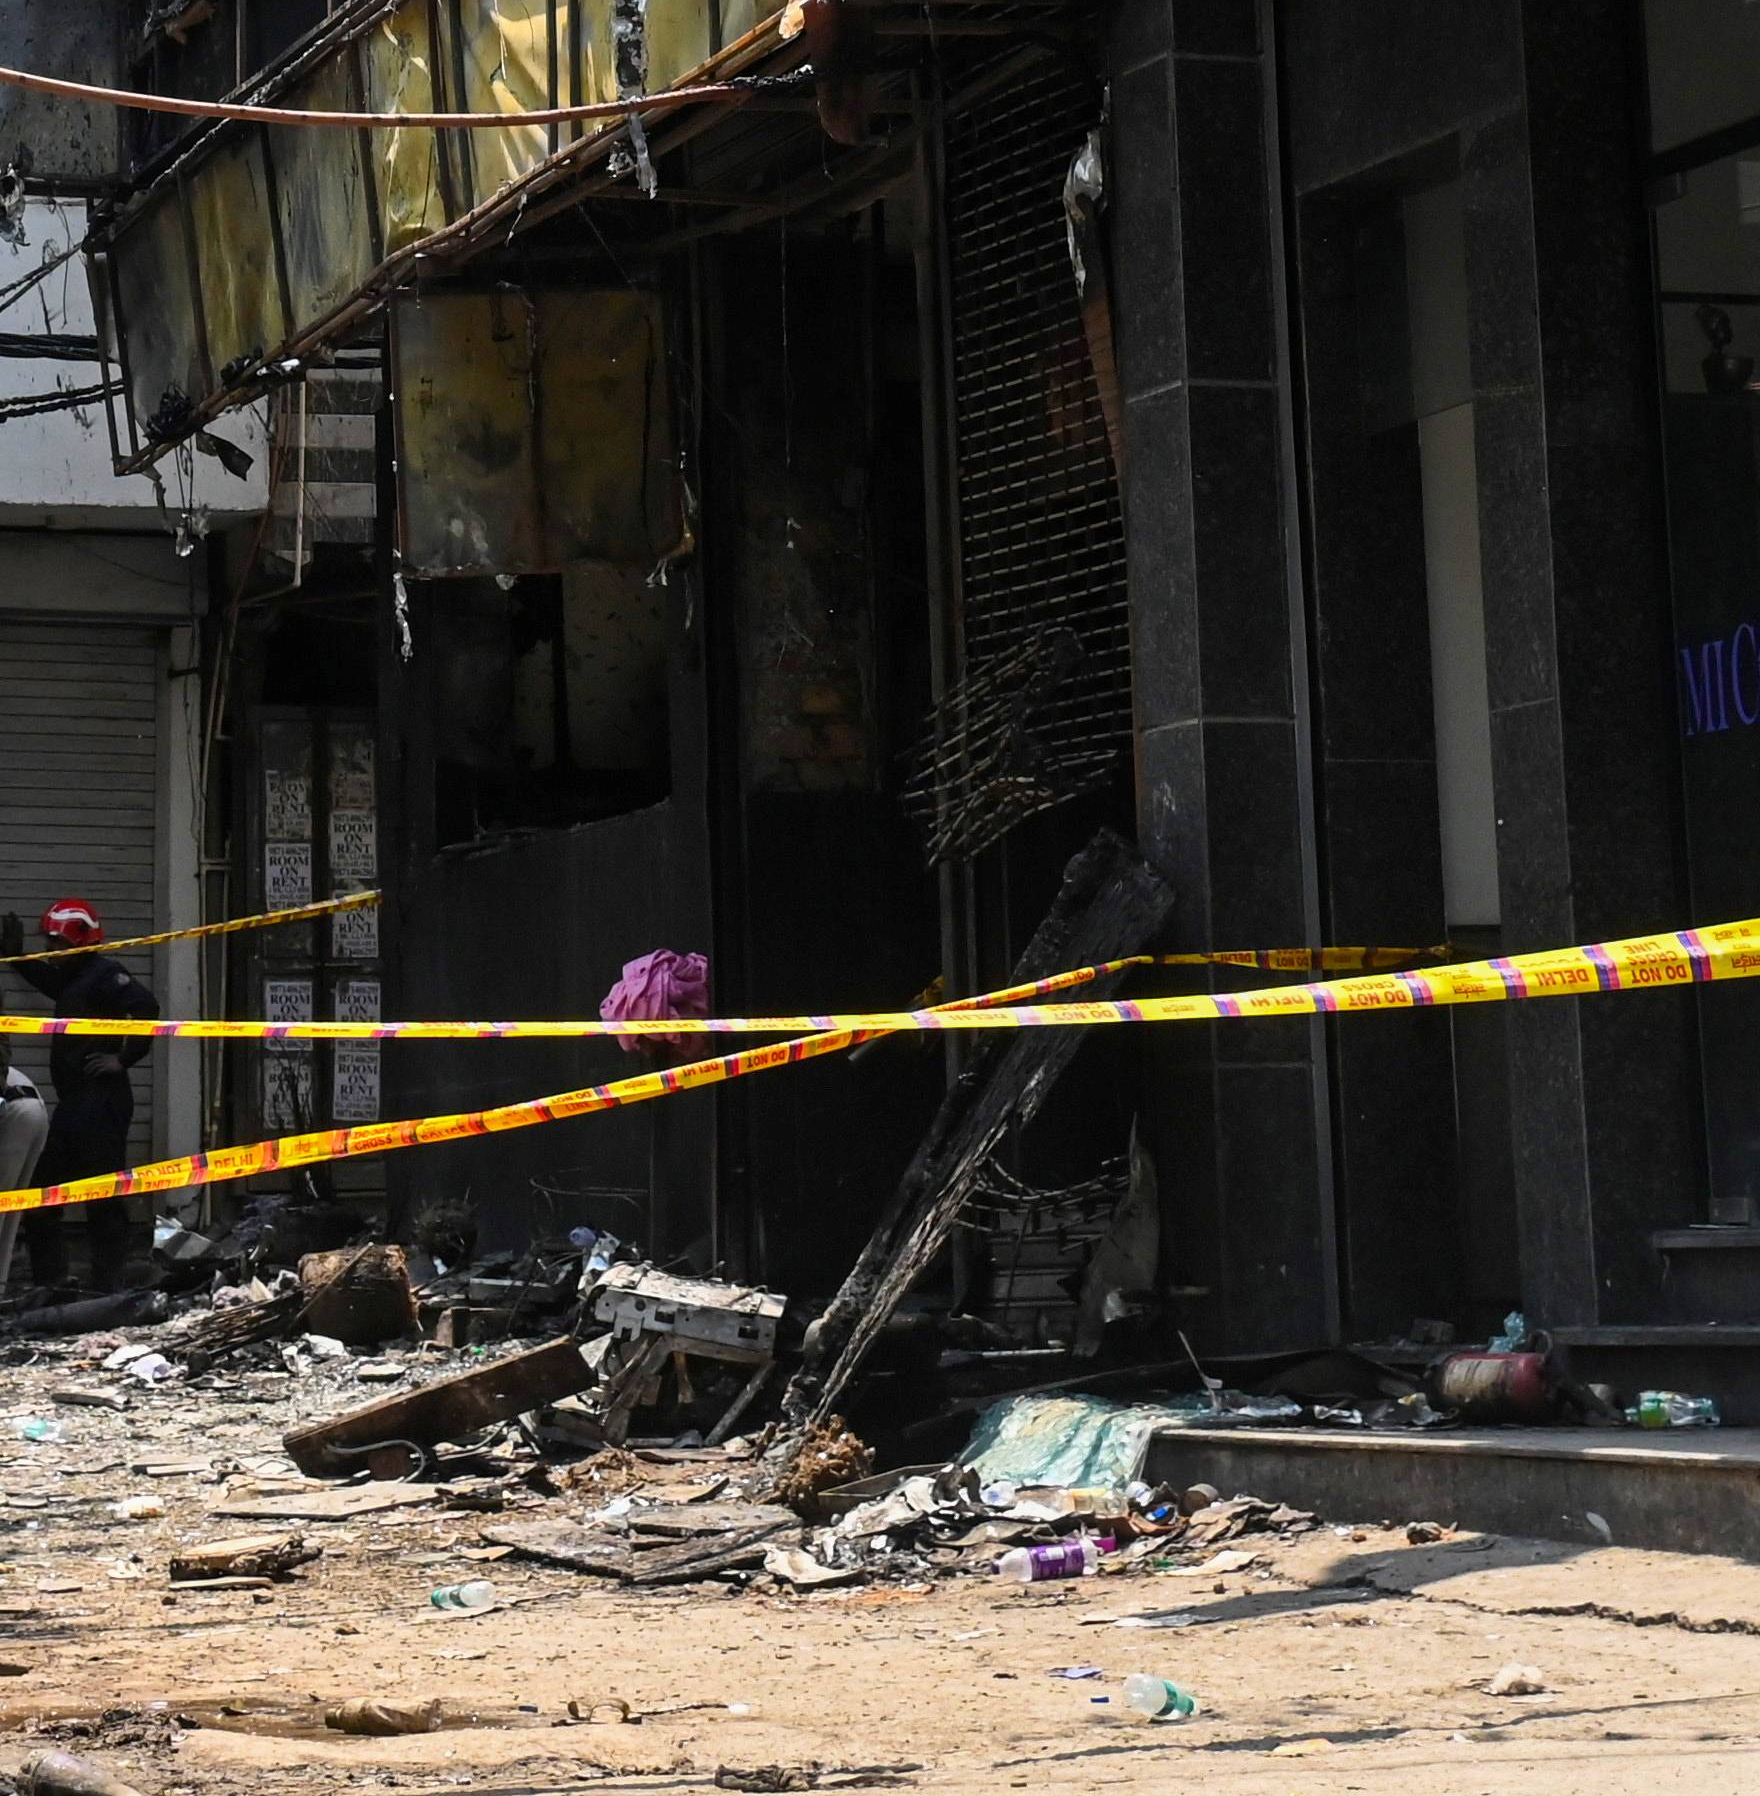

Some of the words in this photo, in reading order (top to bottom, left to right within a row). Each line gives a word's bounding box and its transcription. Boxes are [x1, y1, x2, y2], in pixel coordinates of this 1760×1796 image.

[335, 823, 373, 833] ROOM
[344, 833, 362, 843] ON
[337, 844, 370, 854] RENT
[270, 856, 309, 866] ROOM
[280, 867, 299, 877] ON
[272, 877, 307, 887] RENT
[346, 912, 365, 922] ON
[340, 923, 372, 933] RENT
[1631, 965, 1663, 985] NOT
[1665, 963, 1689, 981] DO
[1534, 968, 1591, 988] DELHI
[270, 995, 310, 1005] ROOM
[340, 995, 378, 1005] ROOM
[1347, 990, 1382, 1007] NOT
[1384, 989, 1409, 1005] DO
[280, 1004, 299, 1015] ON
[349, 1005, 367, 1015] ON
[746, 1054, 769, 1069] NOT
[771, 1050, 787, 1063] DO
[339, 1065, 378, 1075] ROOM
[348, 1075, 367, 1085] ON
[341, 1085, 374, 1096] RENT
[354, 1135, 393, 1152] CROSS
[213, 1153, 254, 1170] DELHI
